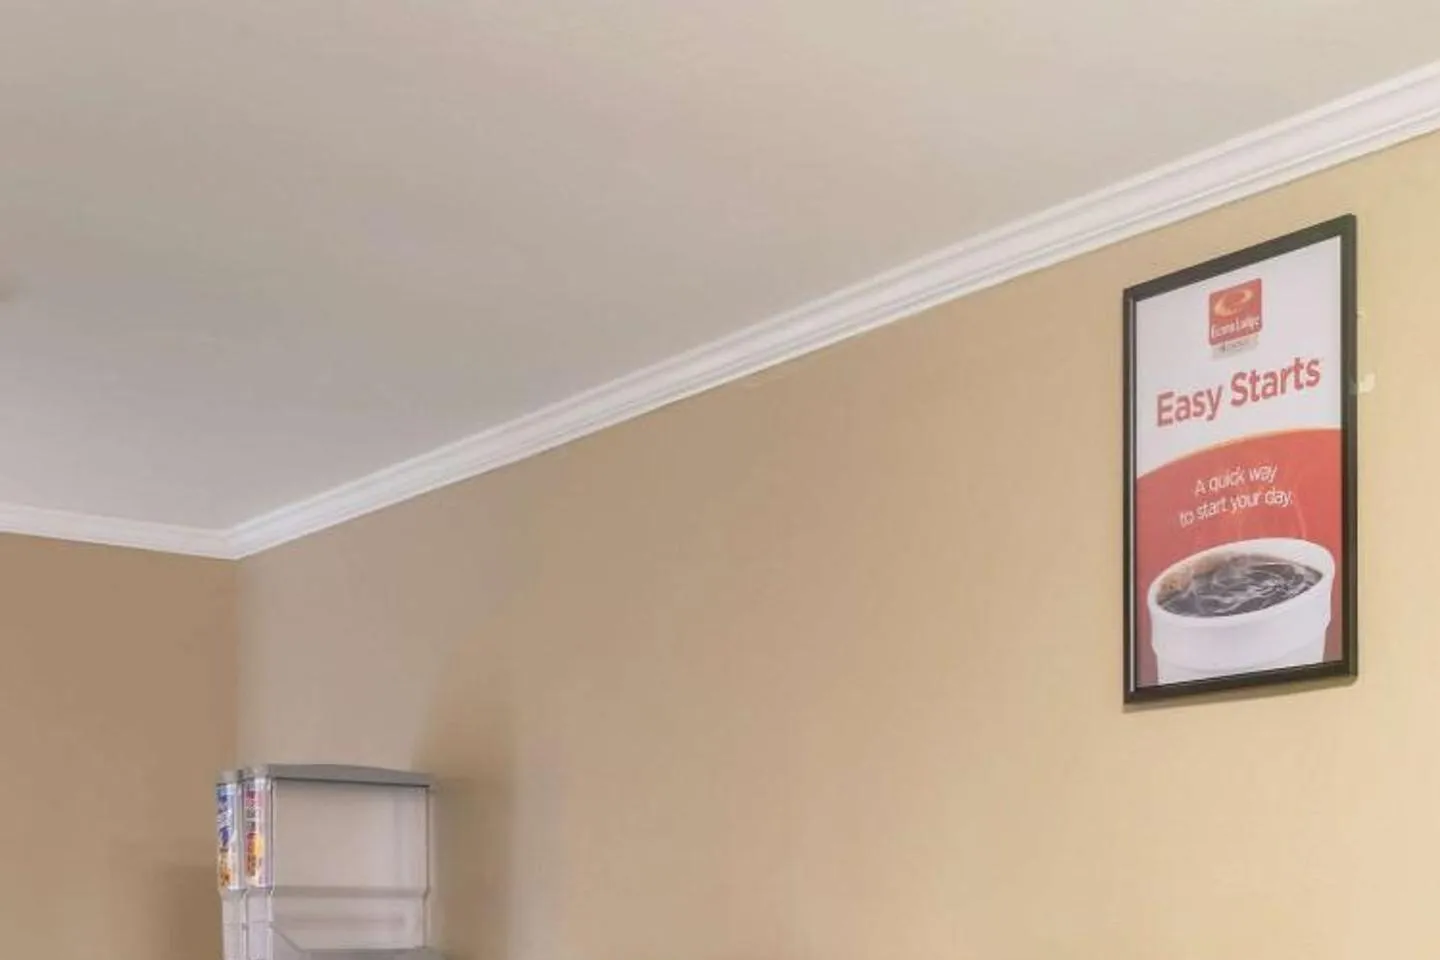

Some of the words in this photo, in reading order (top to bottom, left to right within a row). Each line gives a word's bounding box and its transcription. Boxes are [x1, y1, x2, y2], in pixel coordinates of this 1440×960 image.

[1157, 385, 1223, 427] Easy
[1230, 357, 1321, 407] Starts
[1195, 480, 1206, 494] A
[1208, 466, 1246, 493] quick
[1249, 463, 1278, 483] way
[1179, 510, 1195, 527] to
[1197, 499, 1227, 520] start
[1230, 492, 1261, 513] your
